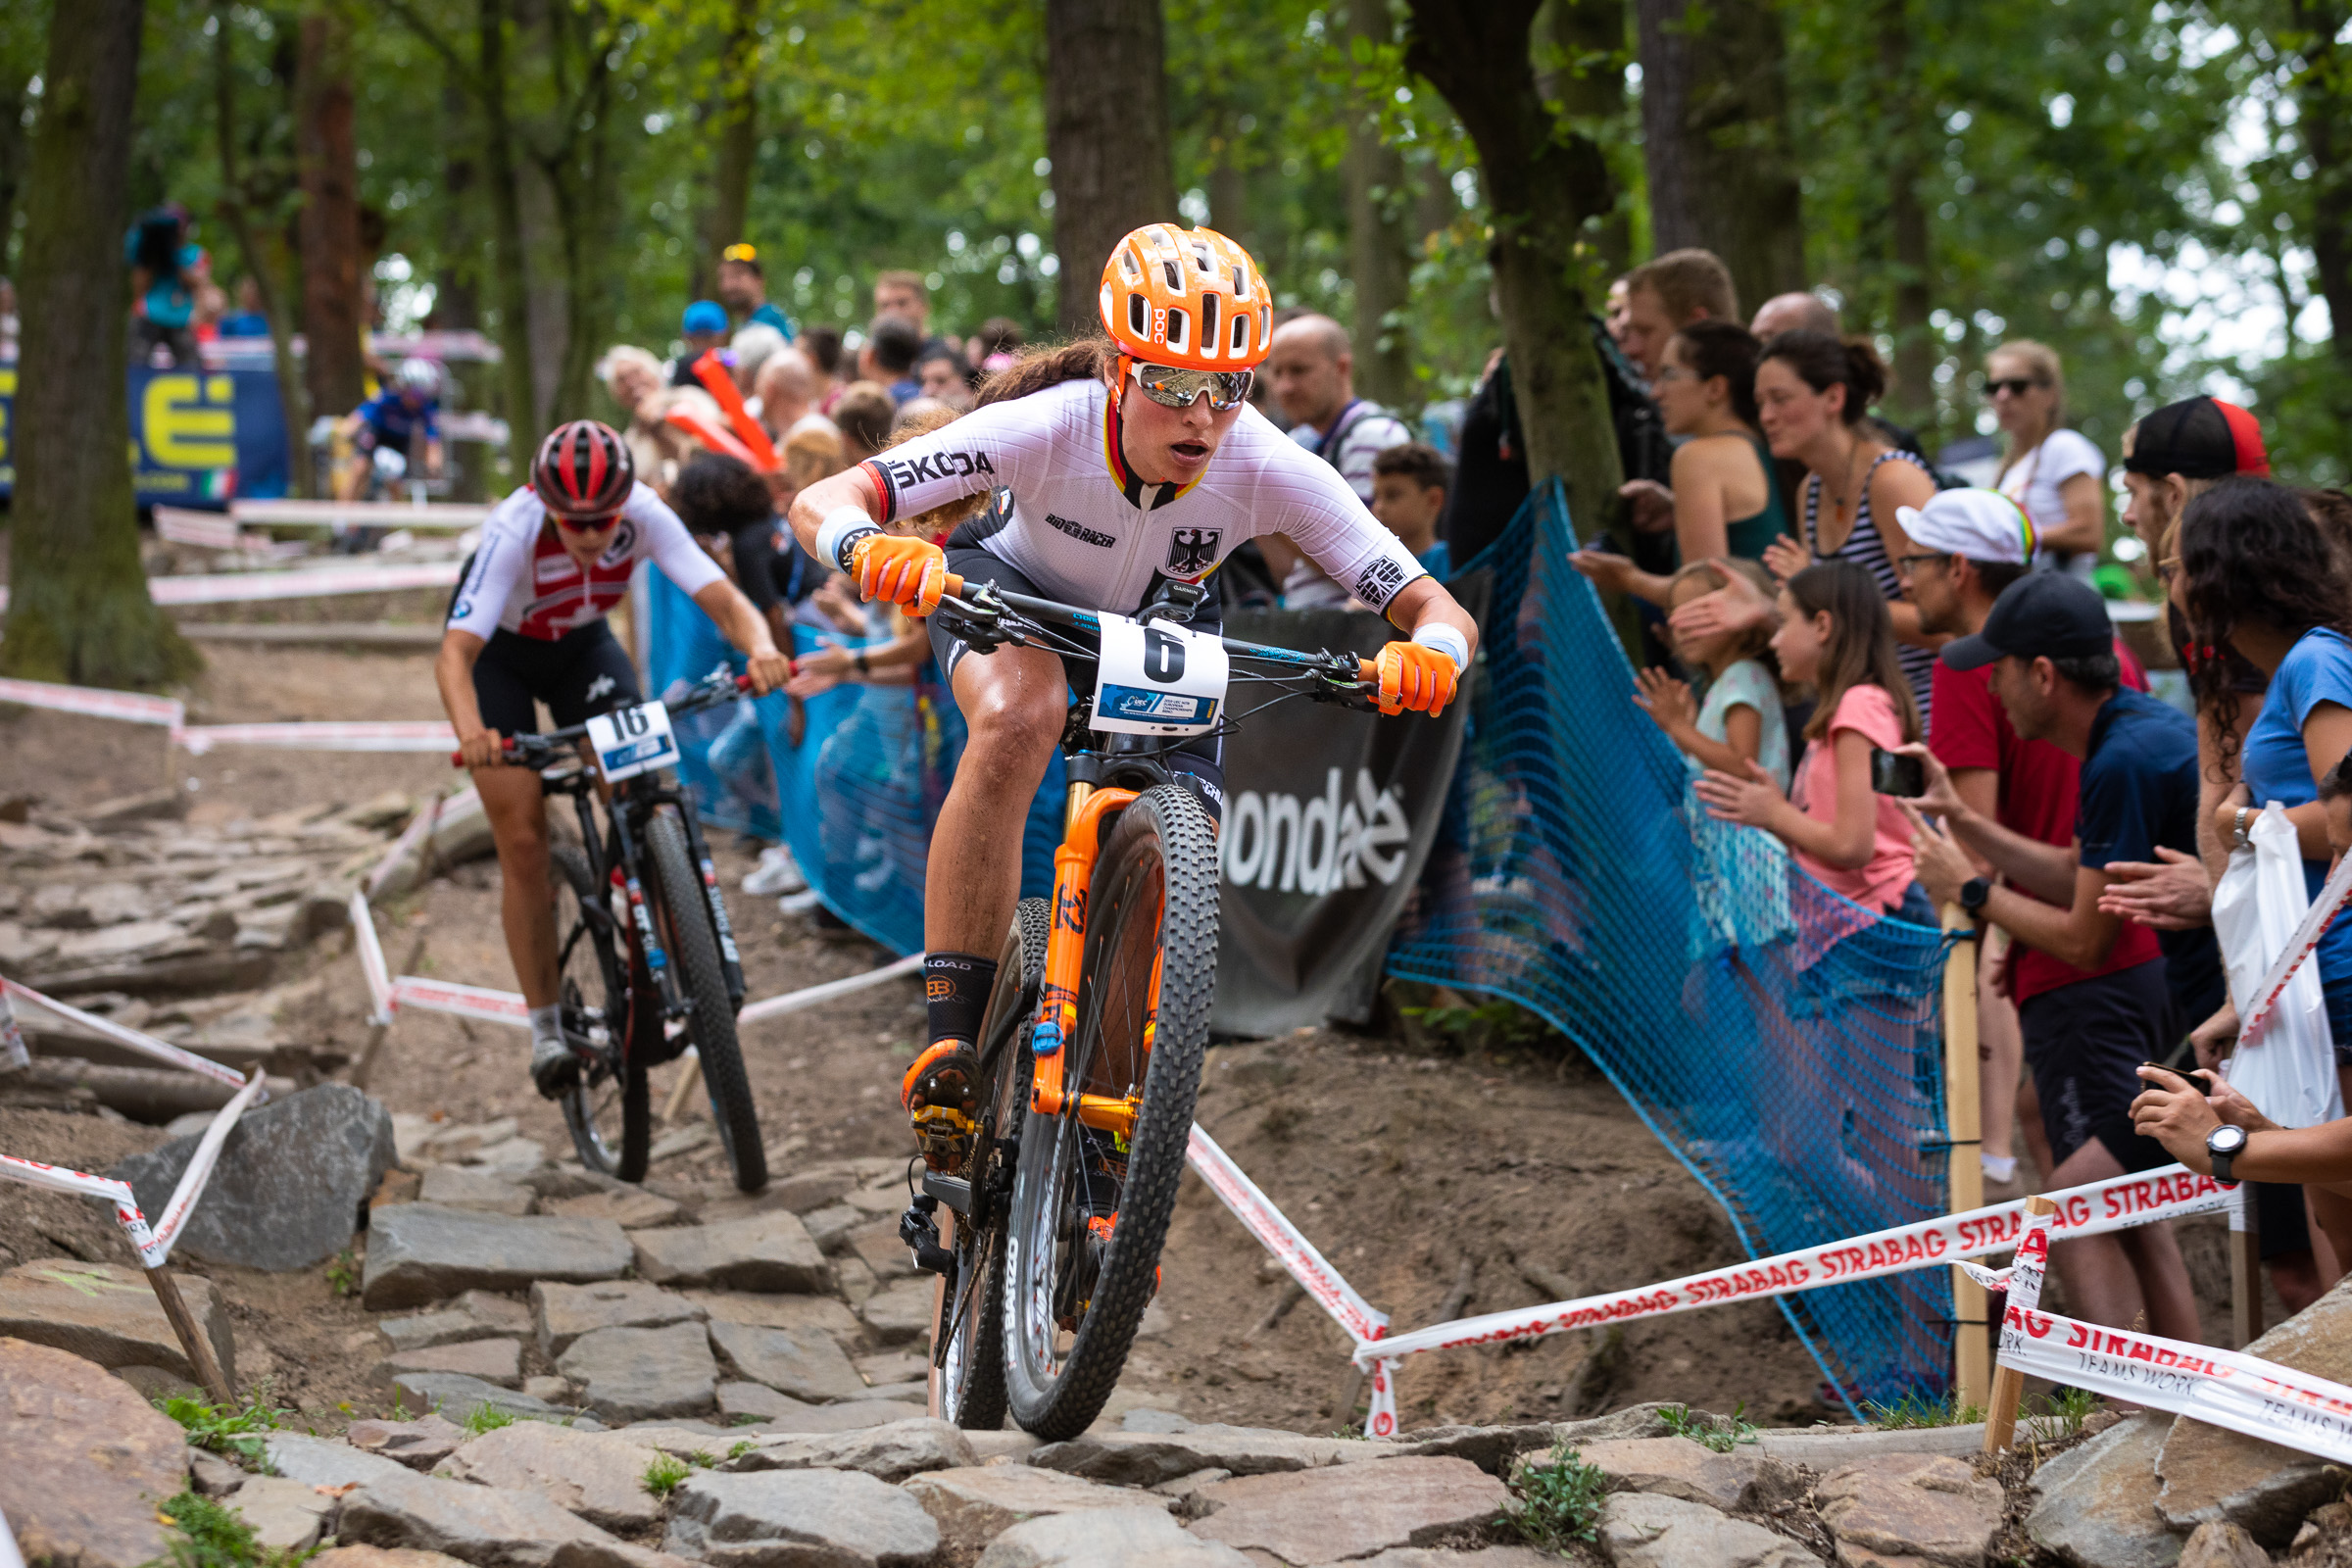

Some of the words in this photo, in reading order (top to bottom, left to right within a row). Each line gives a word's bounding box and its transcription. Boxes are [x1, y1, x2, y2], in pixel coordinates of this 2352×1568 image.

[888, 450, 996, 490] ŠKODA
[1044, 513, 1066, 530] BIO
[1078, 527, 1116, 549] RACER
[1173, 584, 1199, 596] GARMIN
[1143, 627, 1186, 684] 6
[607, 708, 649, 741] 16
[1004, 1236, 1019, 1330] BARZO
[1558, 1290, 1680, 1330] STRABAG
[1684, 1258, 1810, 1305] STRABAG
[1817, 1227, 1948, 1280] STRABAG
[2078, 1350, 2137, 1382] TEAMS
[2263, 1397, 2331, 1437] TEAMS
